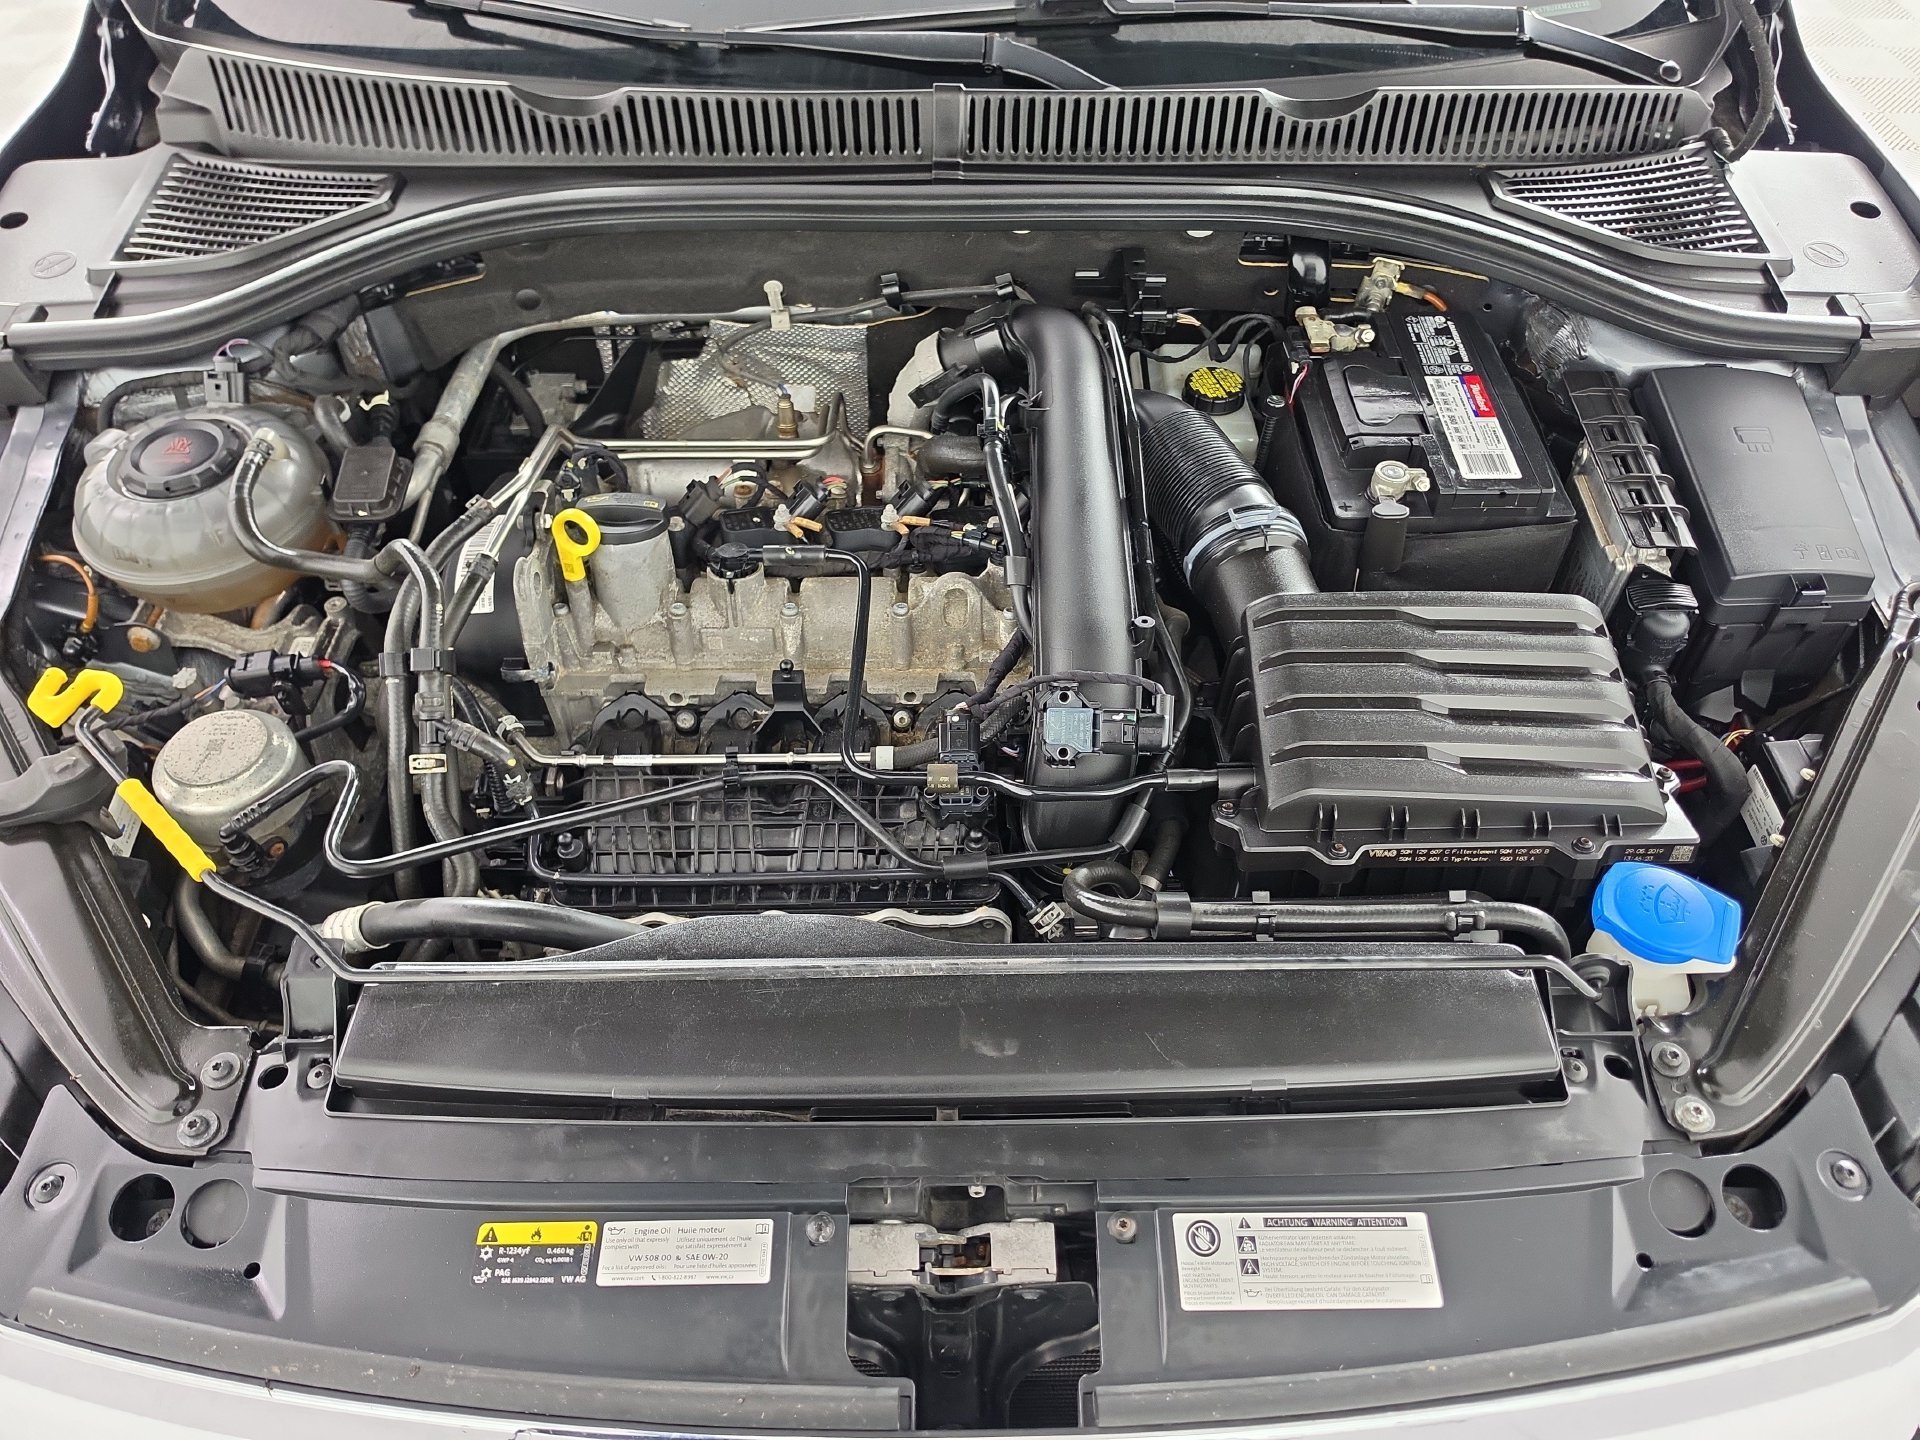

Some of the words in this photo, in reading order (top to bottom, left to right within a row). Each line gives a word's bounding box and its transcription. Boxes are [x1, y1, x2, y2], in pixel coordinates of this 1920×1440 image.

[1266, 1218, 1308, 1226] ACHTUNG
[1311, 1218, 1353, 1226] WARNING
[1356, 1218, 1402, 1226] ATTENTION
[634, 1228, 659, 1236] Engine
[498, 1247, 531, 1257] R-1234yf
[546, 1247, 565, 1255] 0.460
[566, 1247, 575, 1256] kg
